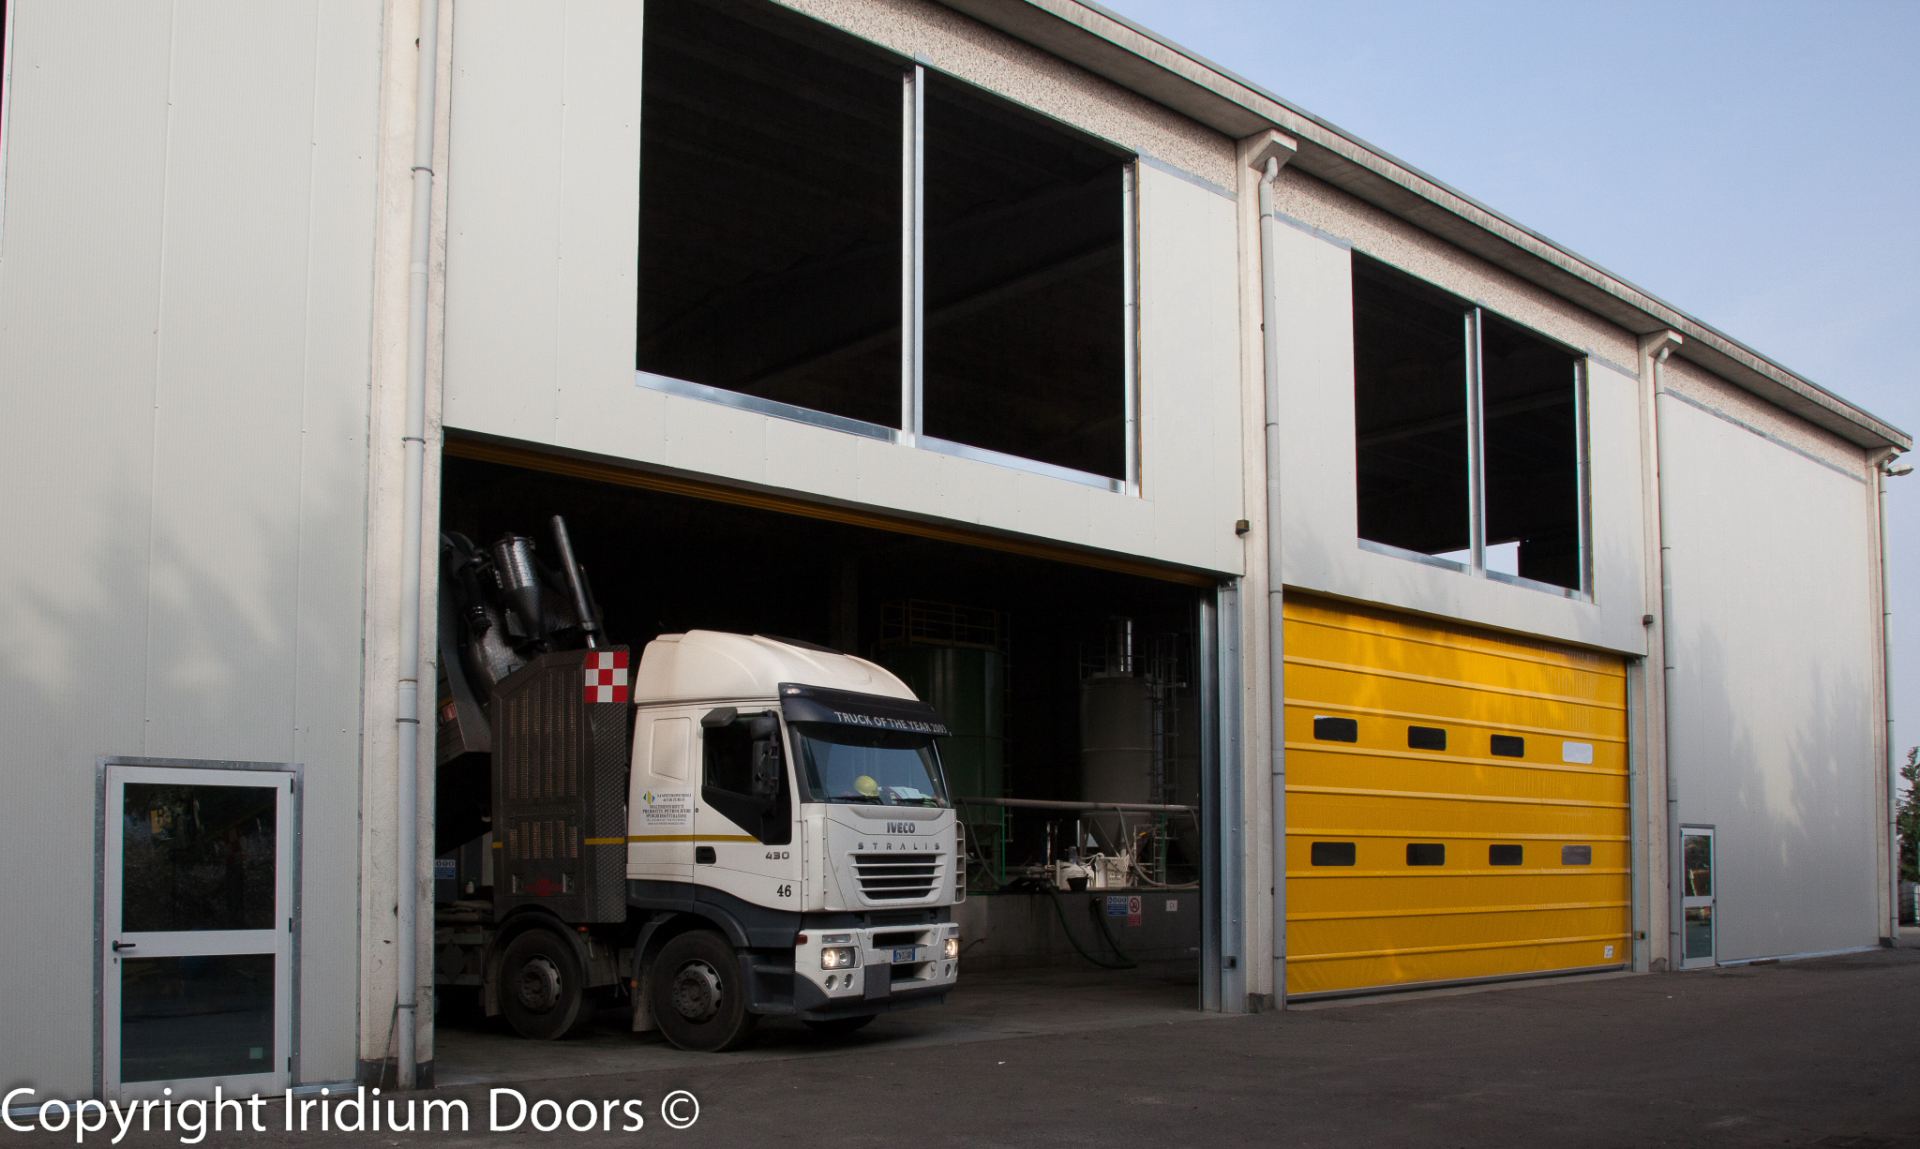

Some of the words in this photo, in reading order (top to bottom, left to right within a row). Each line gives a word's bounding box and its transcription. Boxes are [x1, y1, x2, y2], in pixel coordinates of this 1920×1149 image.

[834, 711, 873, 726] TRUCK
[873, 716, 887, 728] OF
[887, 718, 908, 730] THE
[907, 720, 932, 732] YEAR
[886, 821, 916, 834] IVECO
[857, 841, 940, 850] STRALIS
[765, 851, 790, 860] 430
[776, 884, 792, 898] 46
